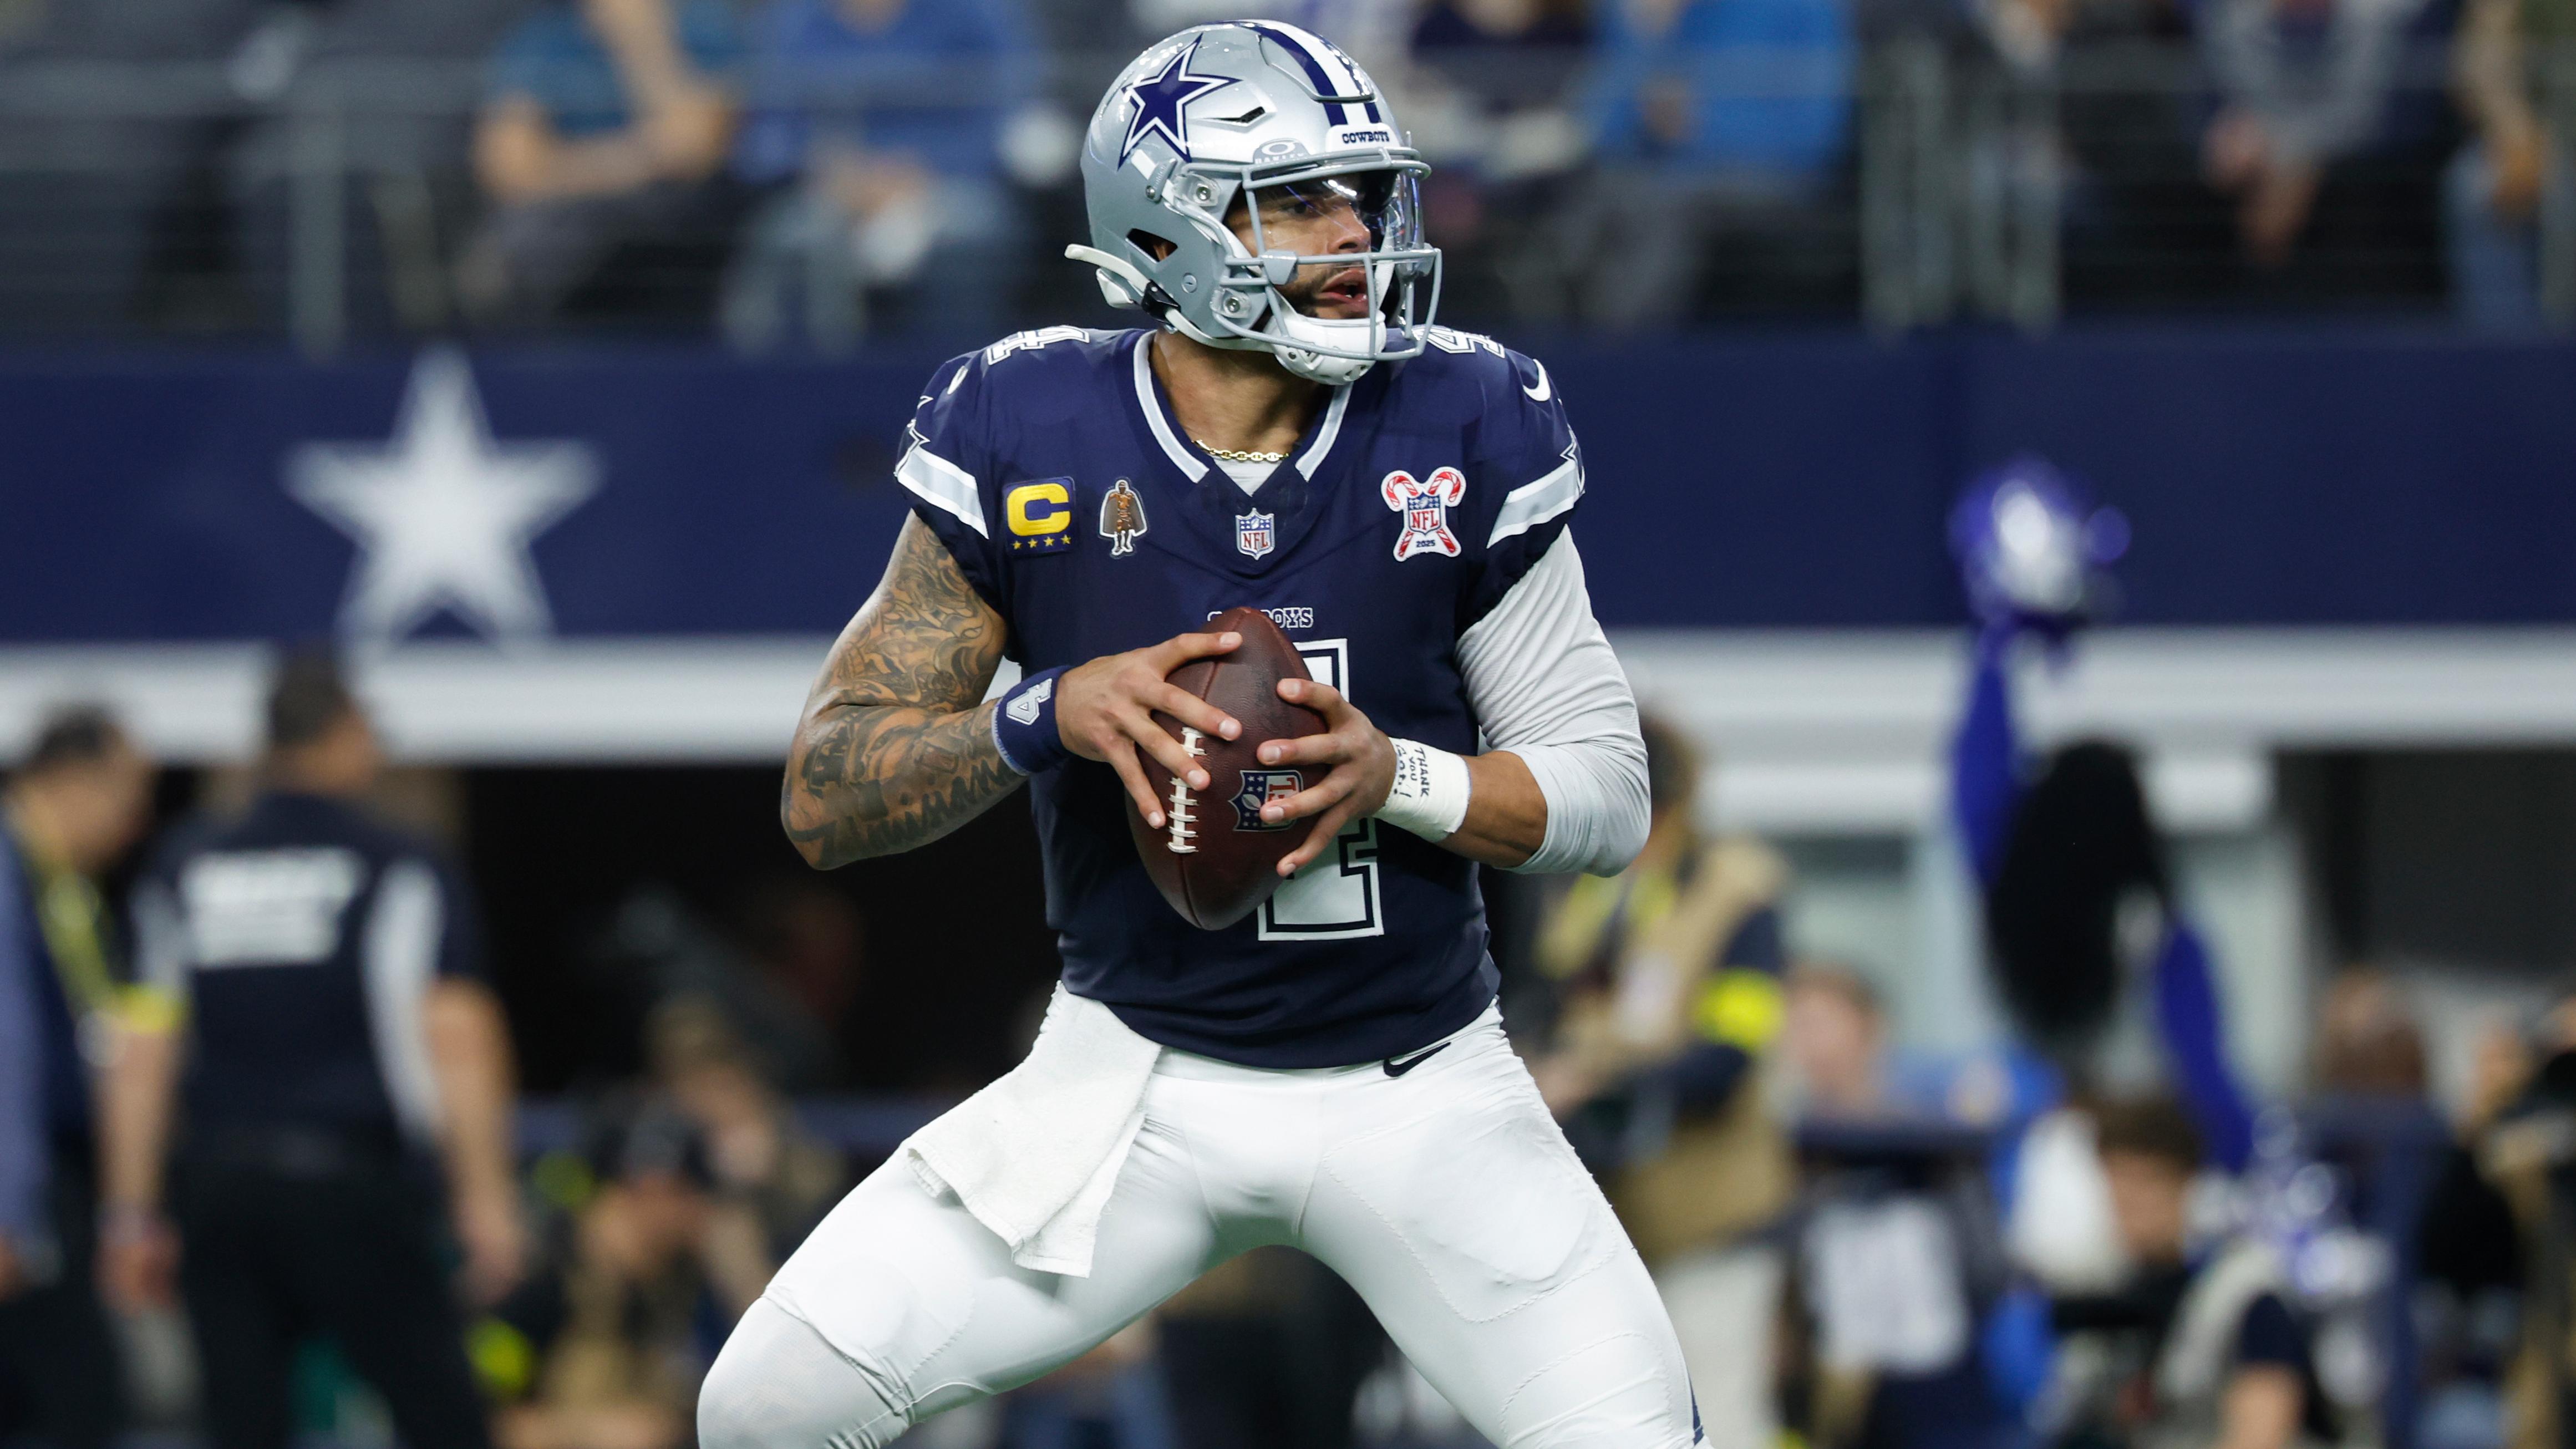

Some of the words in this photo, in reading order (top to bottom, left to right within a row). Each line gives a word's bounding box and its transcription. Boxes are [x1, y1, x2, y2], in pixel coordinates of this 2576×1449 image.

[1007, 483, 1071, 536] C
[1411, 510, 1439, 530] NFL
[1243, 532, 1268, 550] NFL
[1416, 540, 1436, 548] 2025
[1006, 678, 1053, 725] 4
[1409, 756, 1417, 781] YOU
[1414, 747, 1430, 797] THANK
